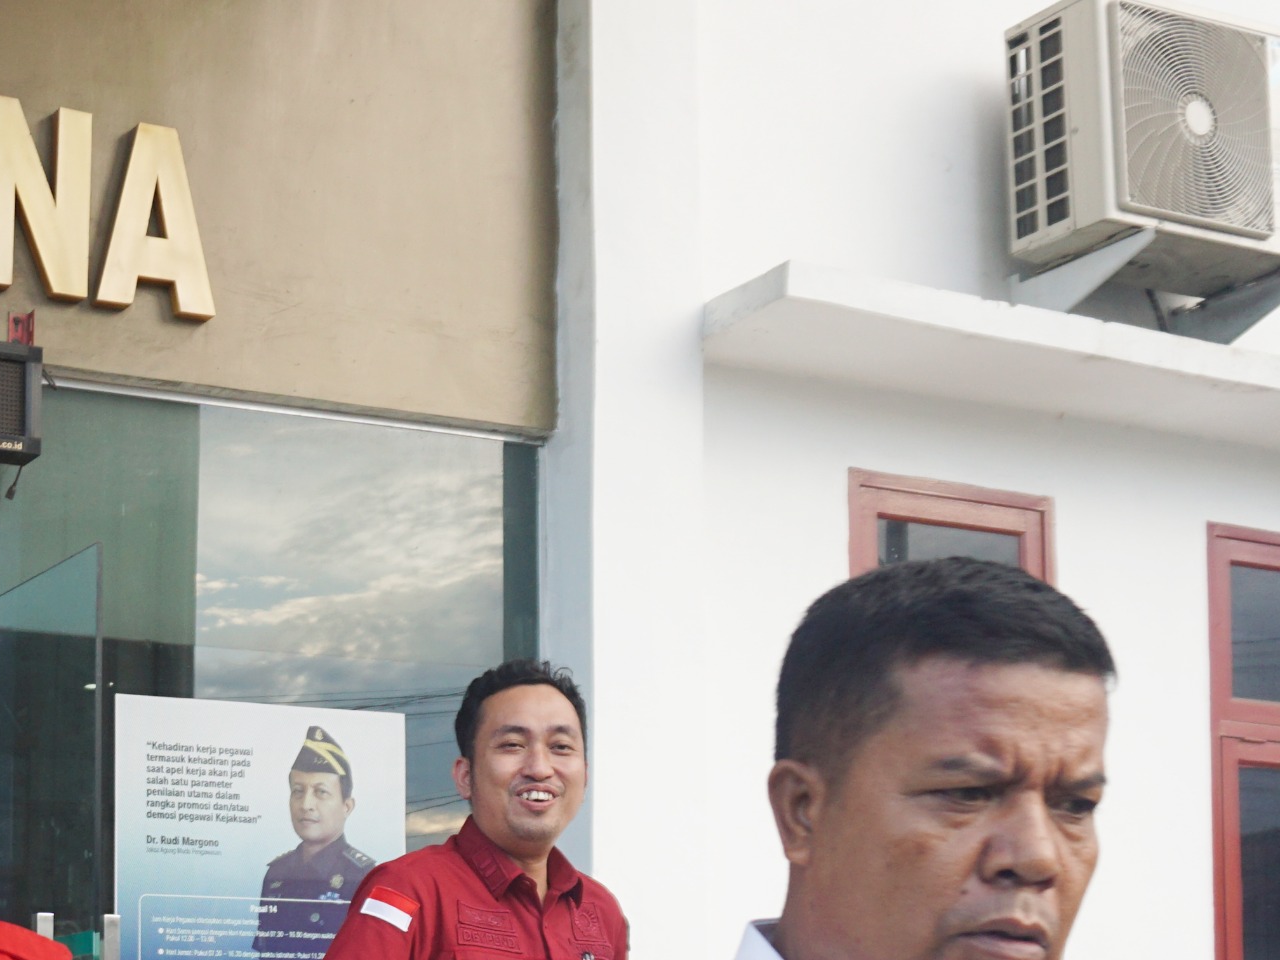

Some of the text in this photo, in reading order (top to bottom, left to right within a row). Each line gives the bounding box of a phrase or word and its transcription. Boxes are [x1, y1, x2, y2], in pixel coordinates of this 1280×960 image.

[197, 744, 216, 755] kerja
[219, 746, 253, 756] pegawai
[147, 753, 250, 768] termasuk kehadiran pada
[147, 764, 245, 778] saat apel kerja akan jadi
[147, 776, 233, 788] salah satu parameter
[147, 788, 240, 800] penilaian utama dalam
[147, 800, 249, 812] rangka promosi dan/atau
[147, 811, 176, 819] demosi
[179, 813, 213, 822] pegawai
[147, 835, 219, 848] Dr. Rudi Margono
